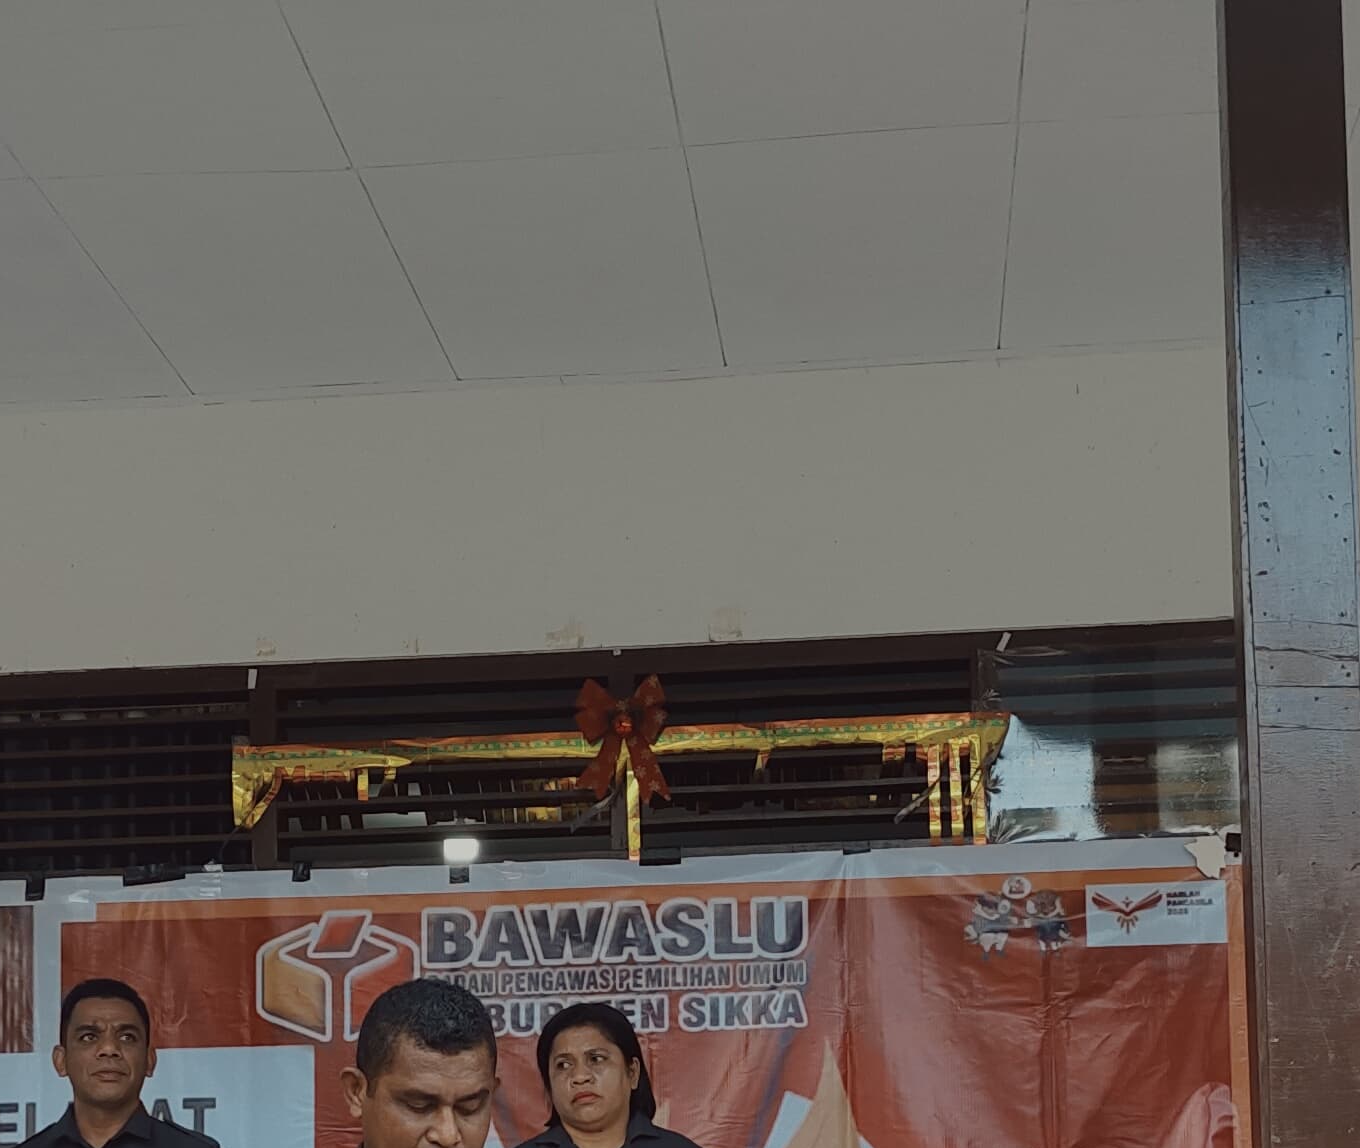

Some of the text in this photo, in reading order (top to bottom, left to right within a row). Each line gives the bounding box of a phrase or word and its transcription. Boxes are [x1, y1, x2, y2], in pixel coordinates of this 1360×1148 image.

[423, 897, 808, 967] BAWASLU
[500, 968, 614, 992] PENGAWAS
[619, 965, 729, 990] PEMILIHAN
[739, 962, 805, 986] UMUM
[681, 992, 806, 1030] SIKKA
